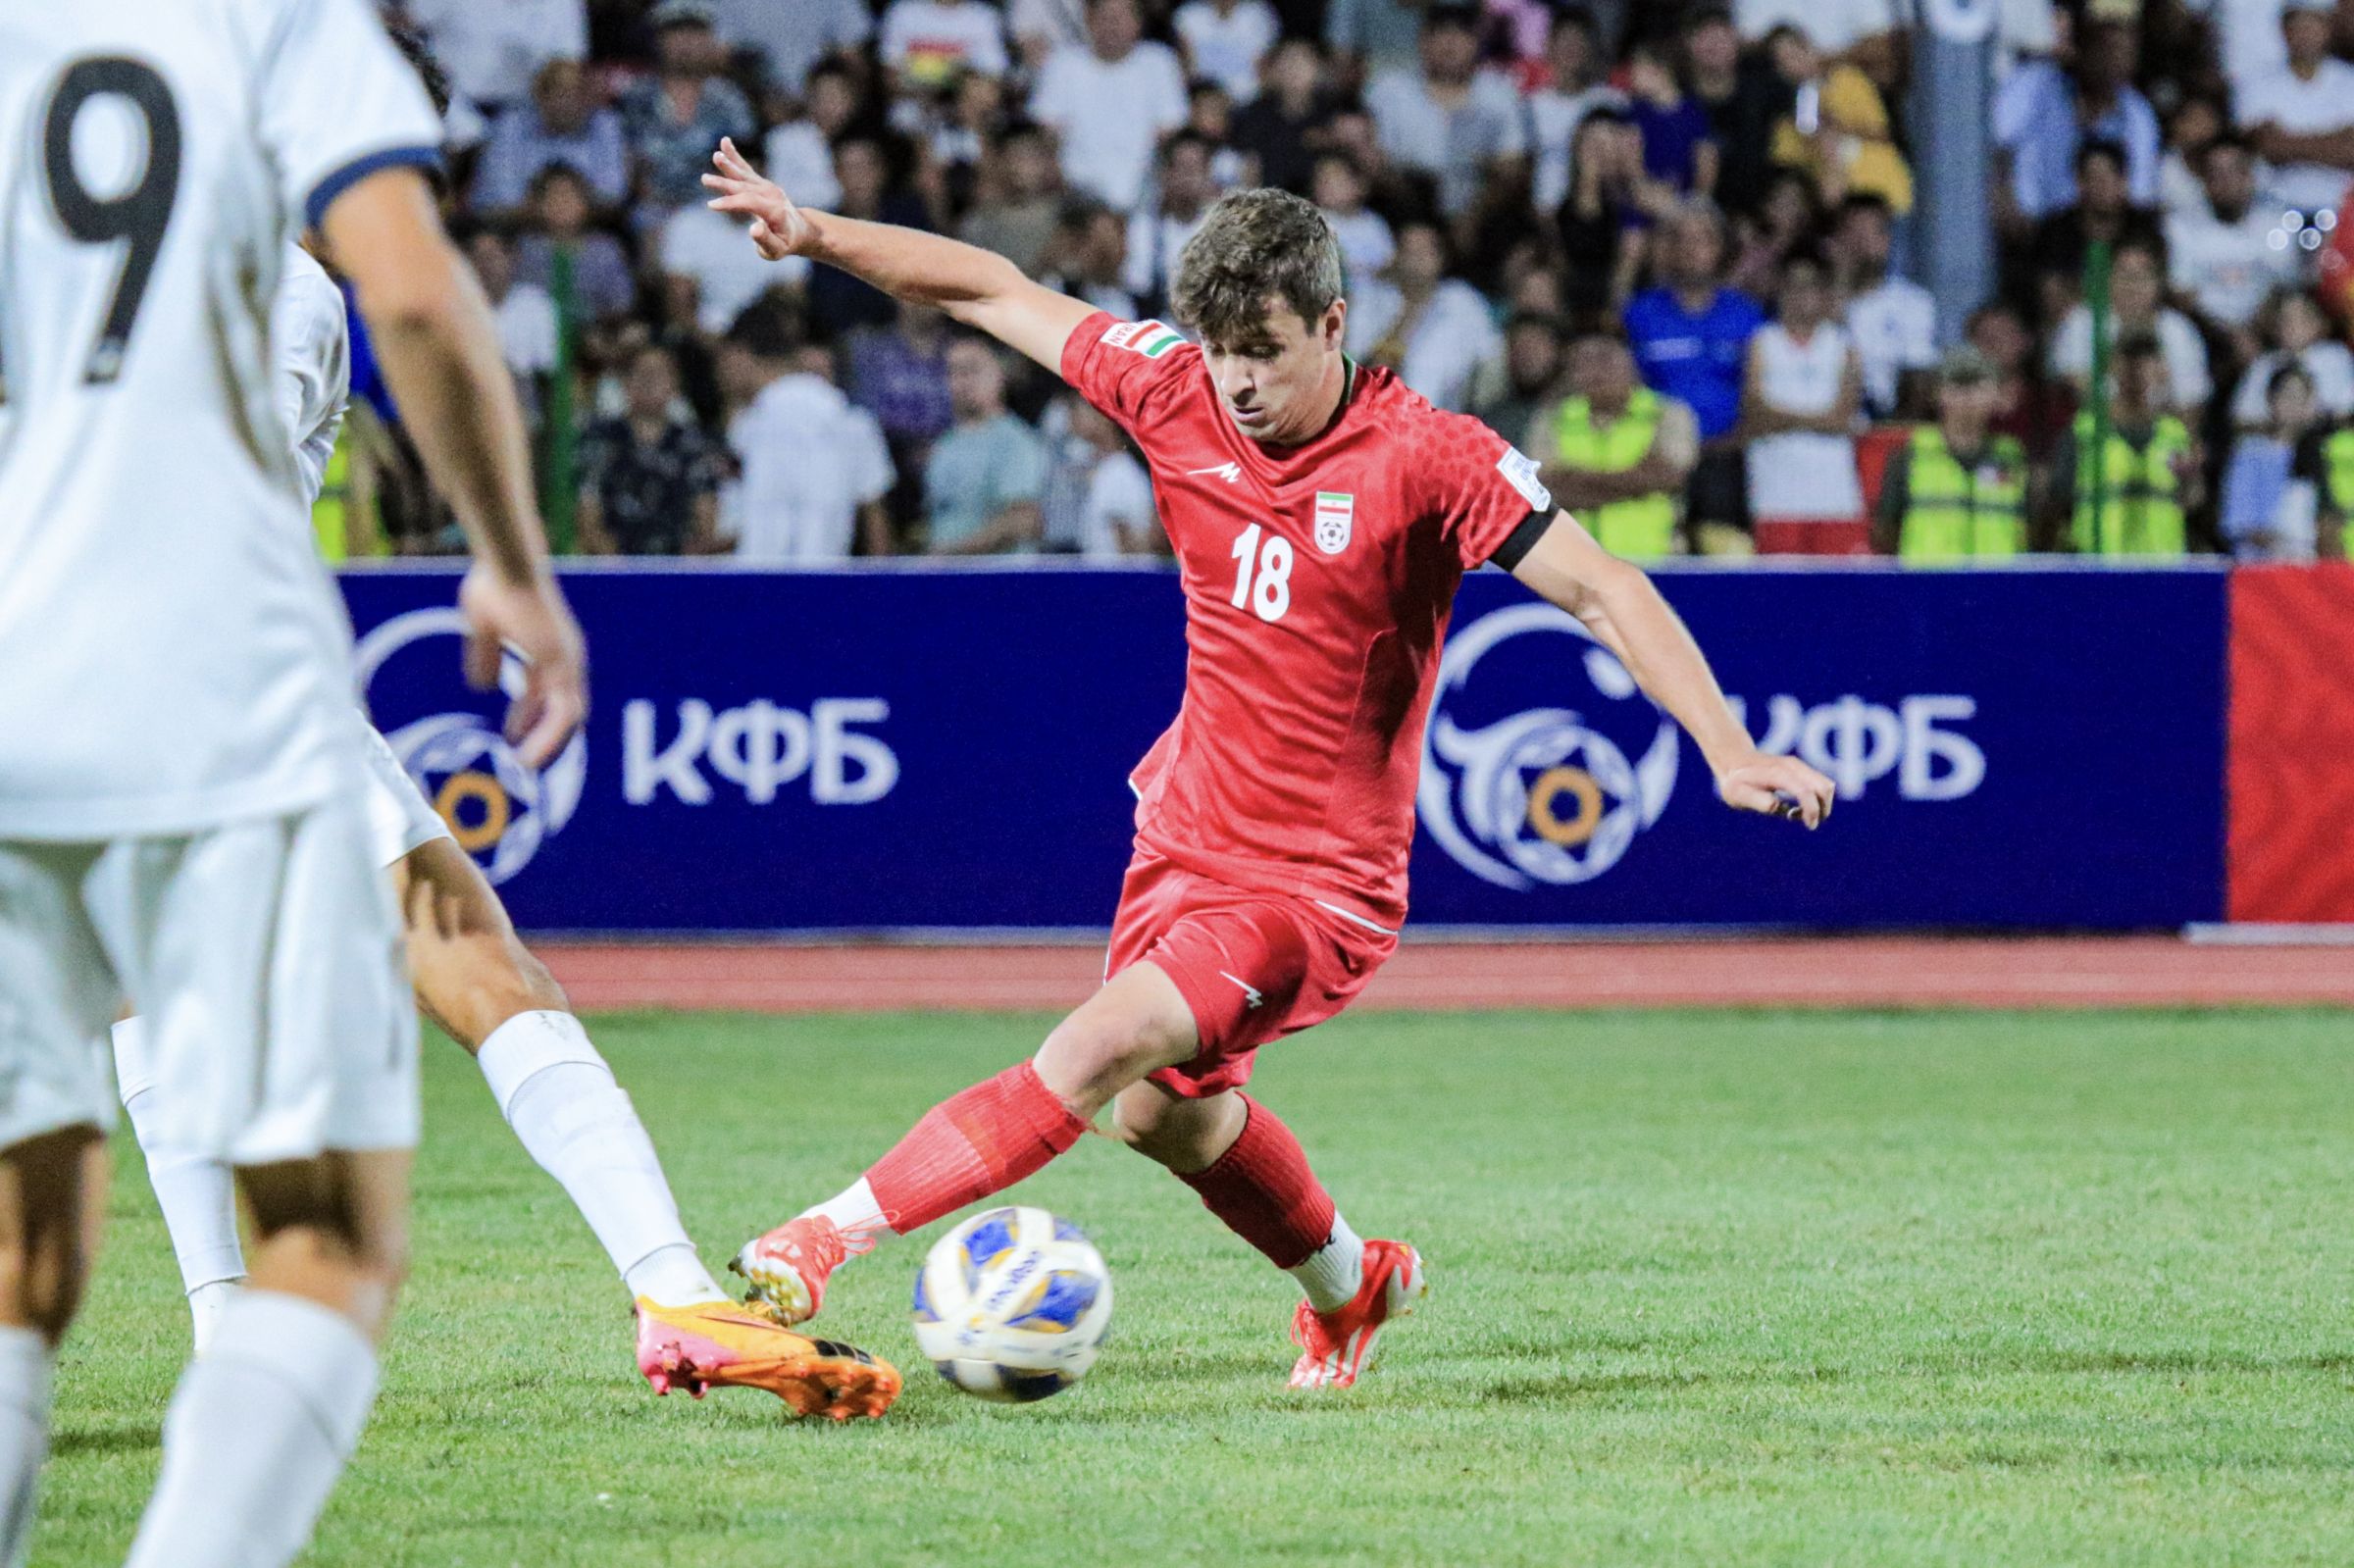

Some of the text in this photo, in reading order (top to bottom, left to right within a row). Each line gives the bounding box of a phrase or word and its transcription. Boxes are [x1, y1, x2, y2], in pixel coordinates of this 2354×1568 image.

[1108, 324, 1136, 343] IRAN
[1231, 522, 1294, 622] 18
[622, 697, 900, 806] КФБ
